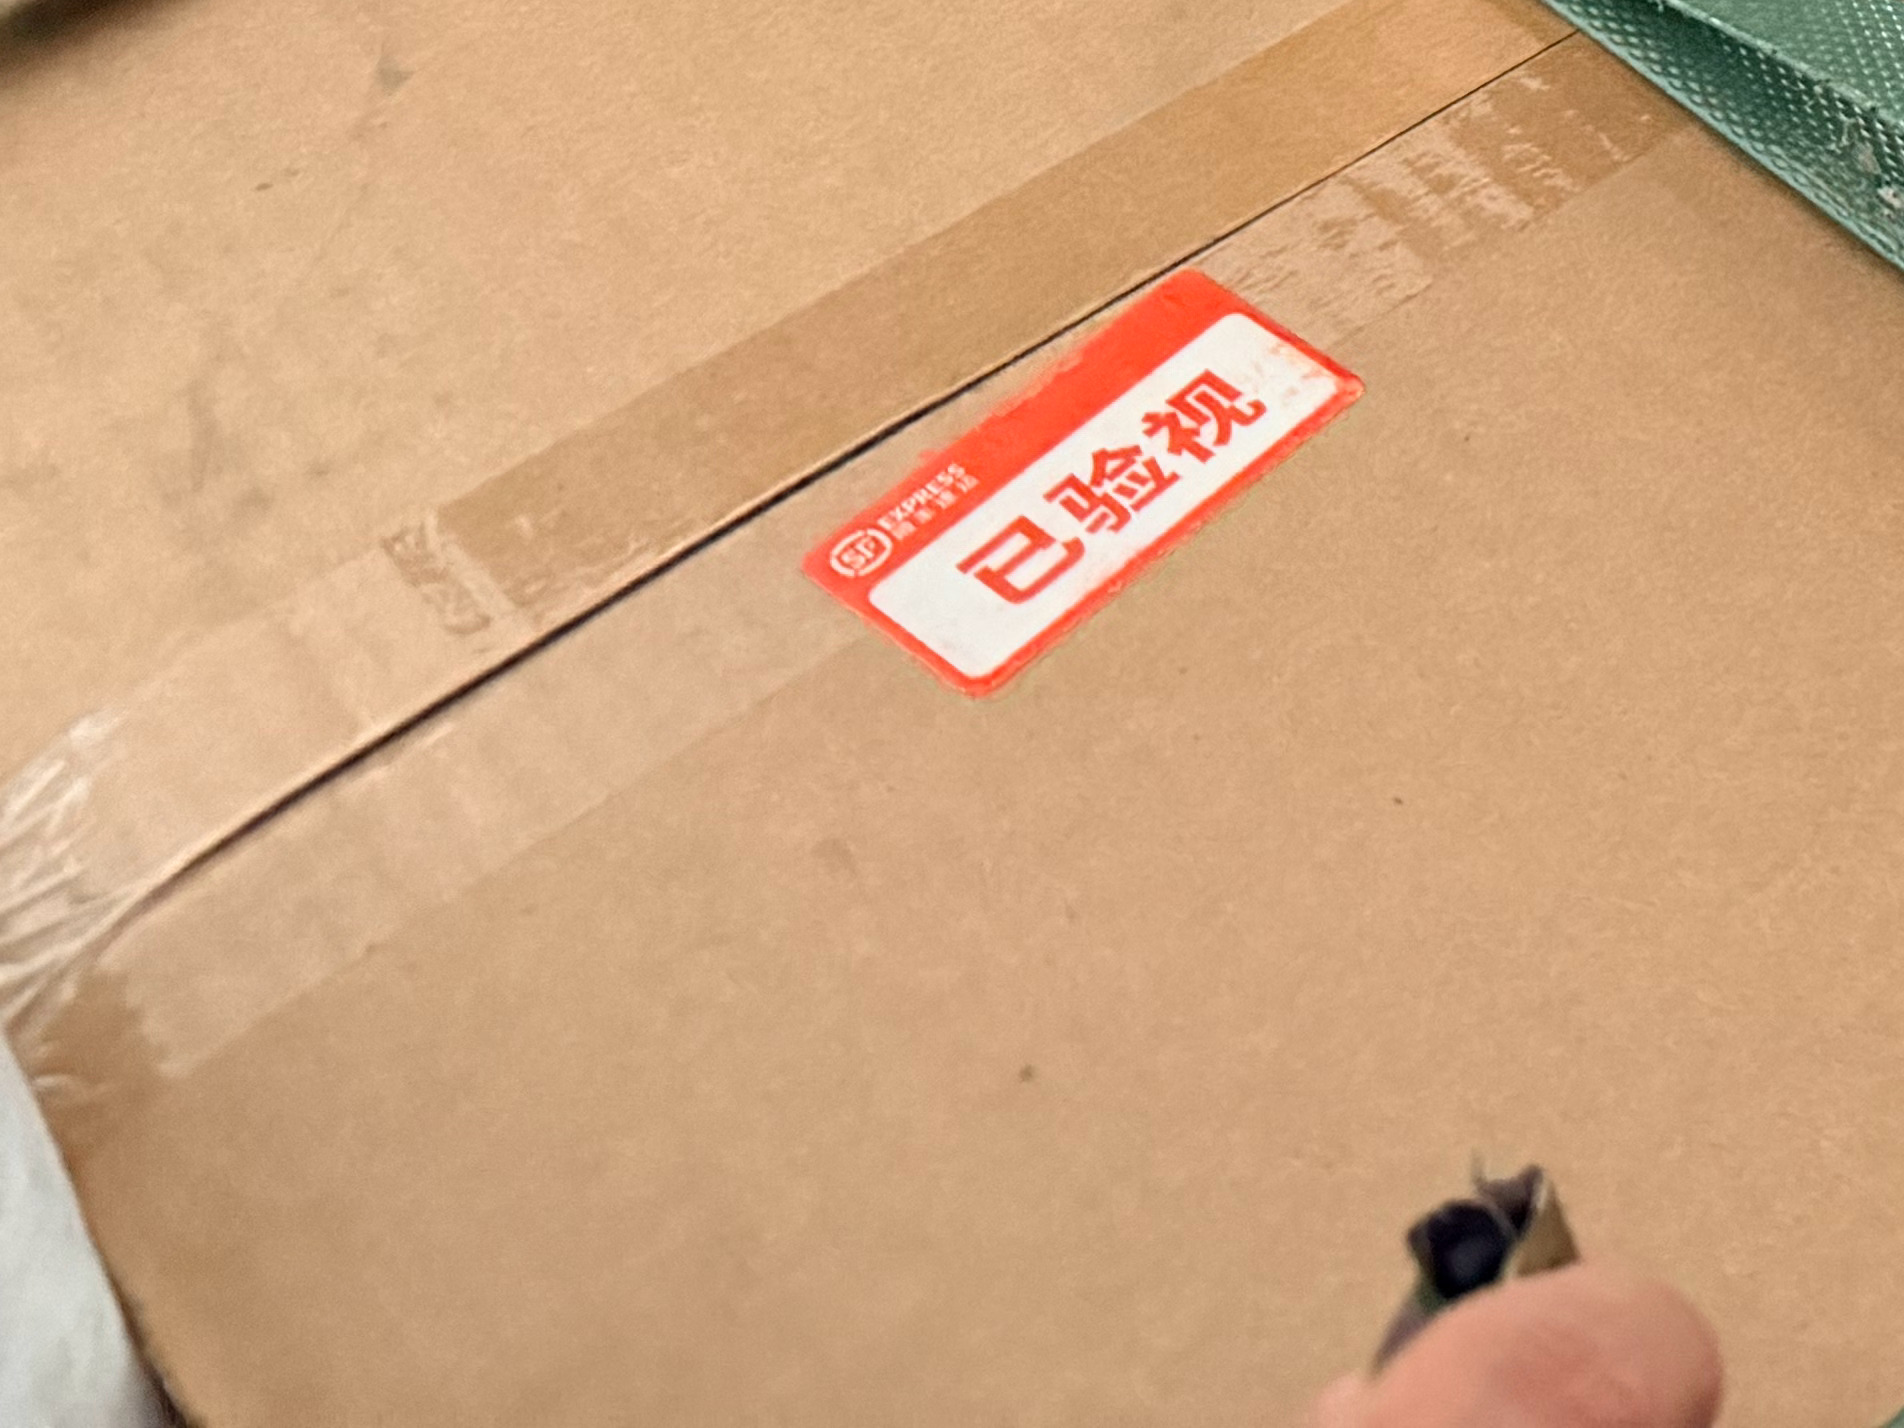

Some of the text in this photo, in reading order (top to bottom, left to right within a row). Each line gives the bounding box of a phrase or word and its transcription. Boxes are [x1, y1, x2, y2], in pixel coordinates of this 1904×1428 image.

[877, 463, 966, 531] EXPRESS
[956, 368, 1268, 606] 已验视
